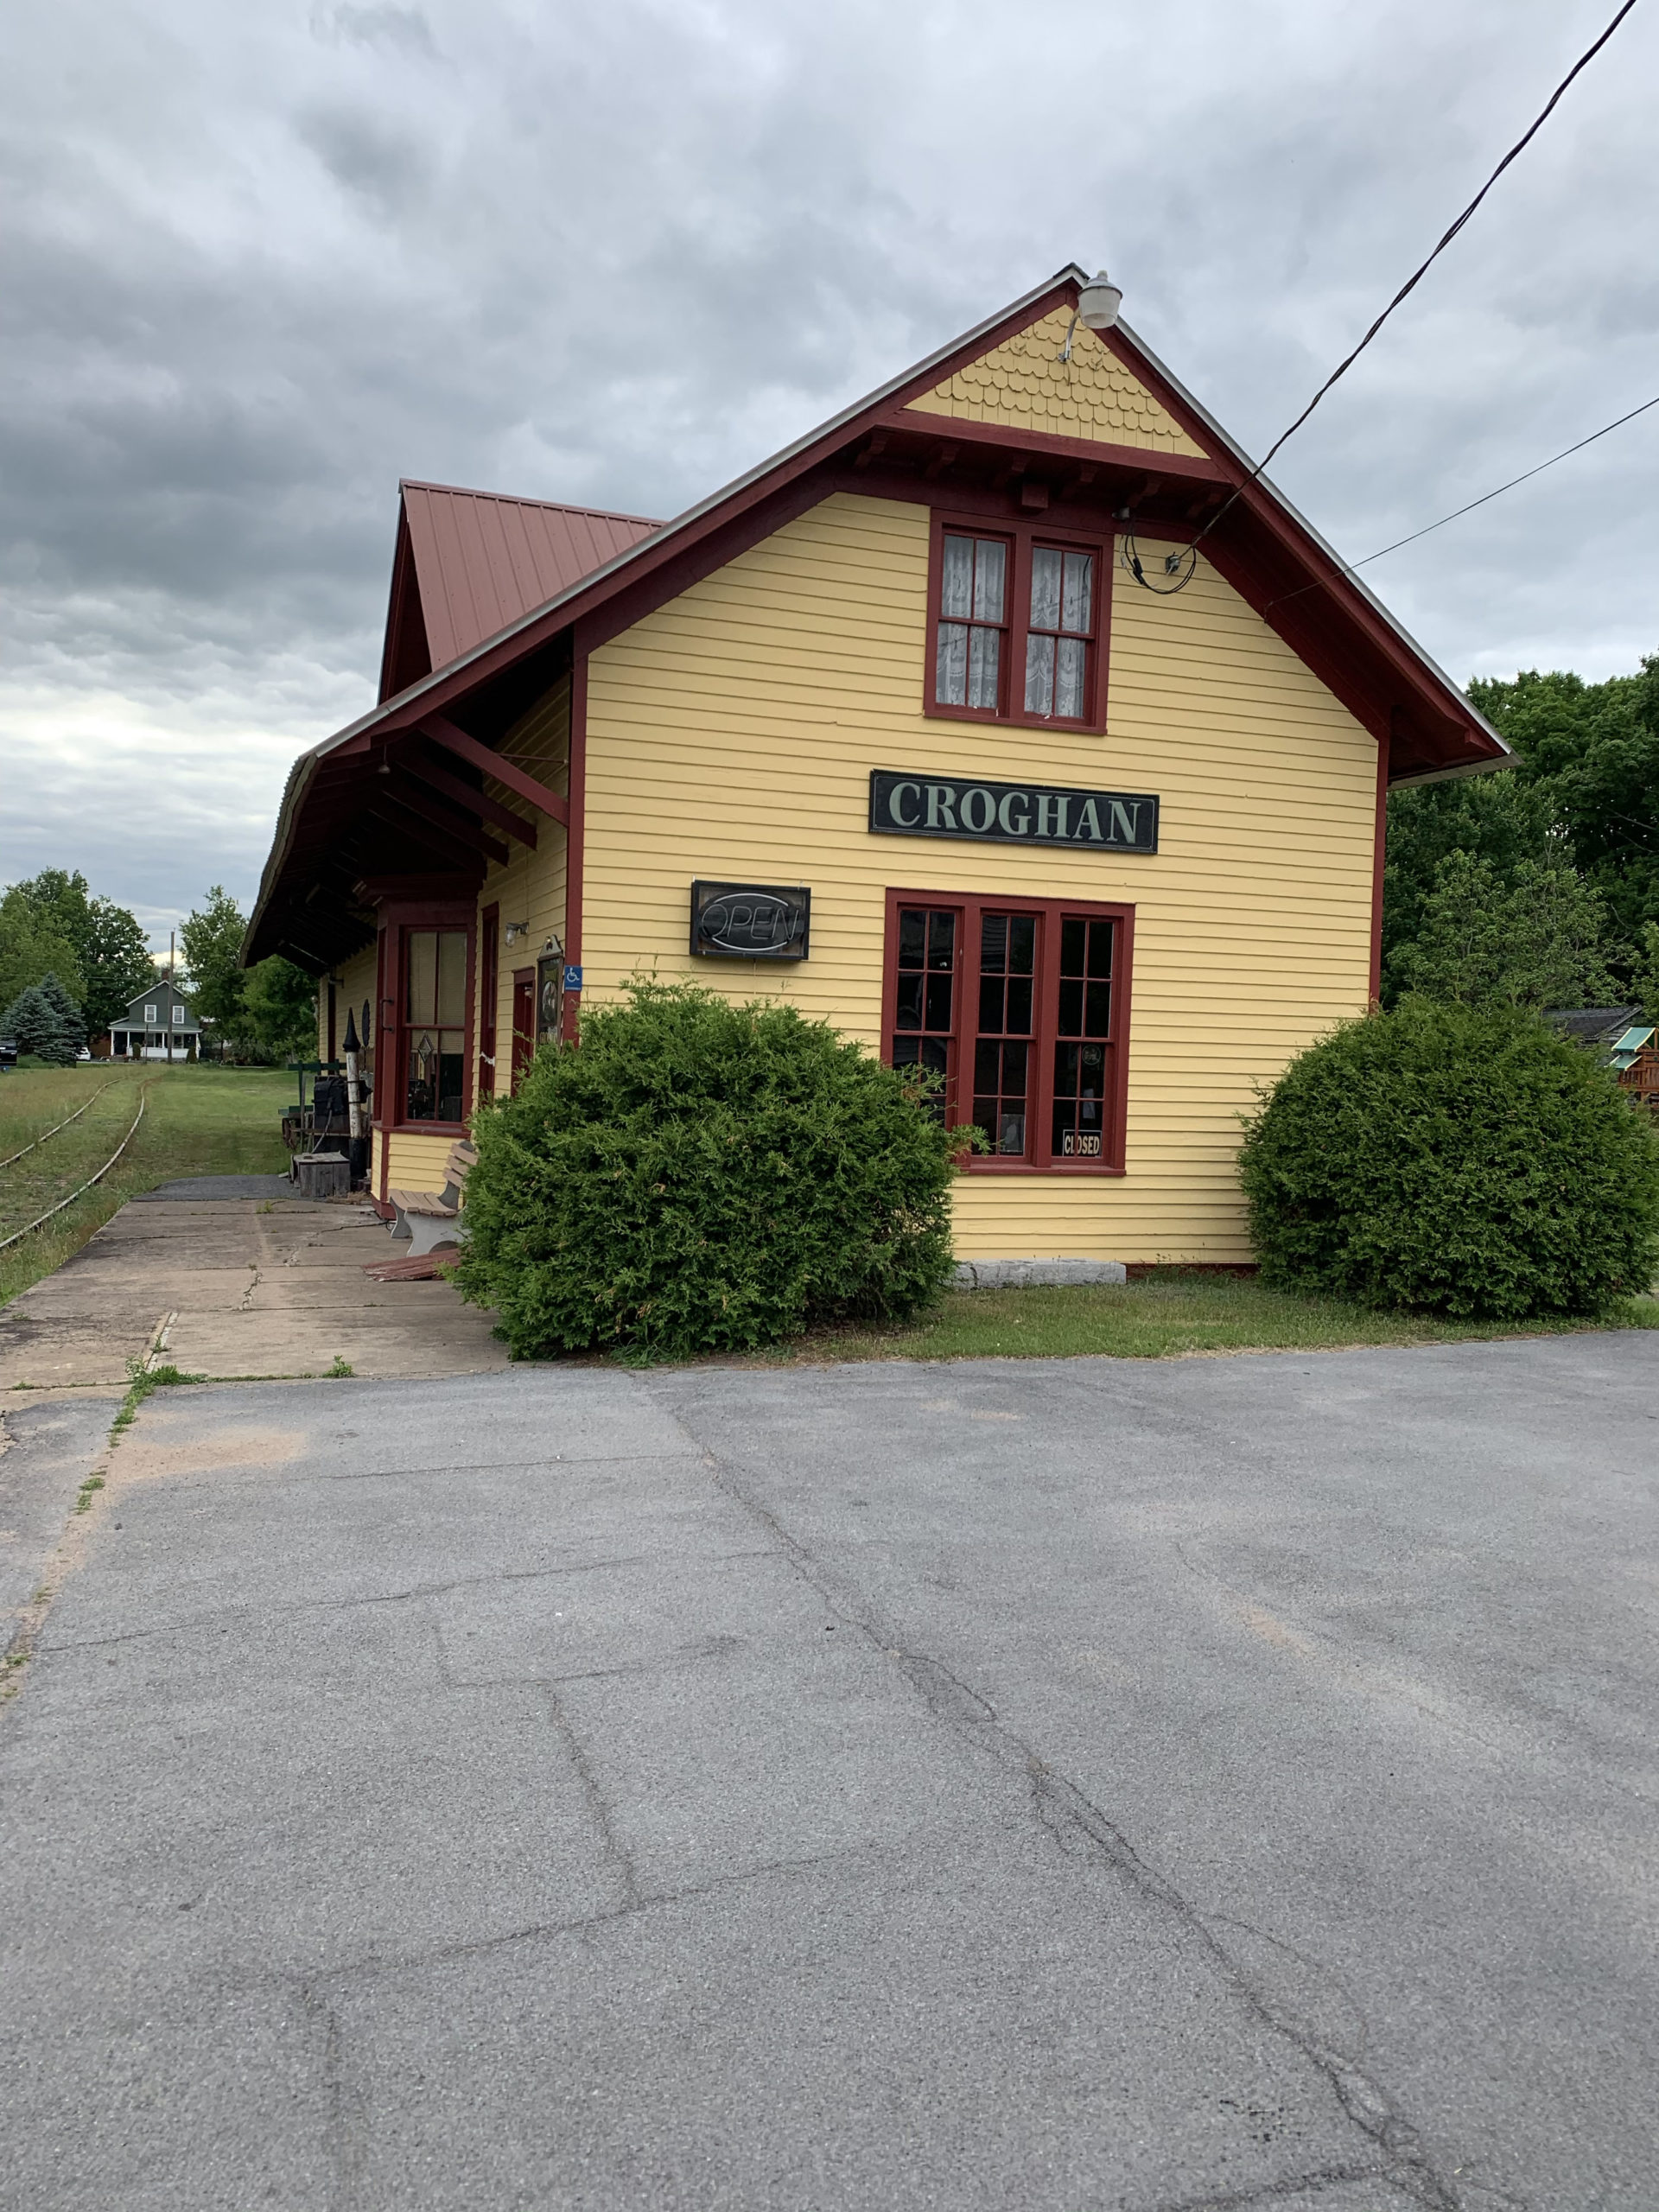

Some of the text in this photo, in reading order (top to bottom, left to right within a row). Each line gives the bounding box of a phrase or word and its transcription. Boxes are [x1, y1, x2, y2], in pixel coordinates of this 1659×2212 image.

[888, 781, 1141, 843] CROGHAN
[701, 904, 799, 940] OPEN
[1064, 1135, 1100, 1154] CLOSED
